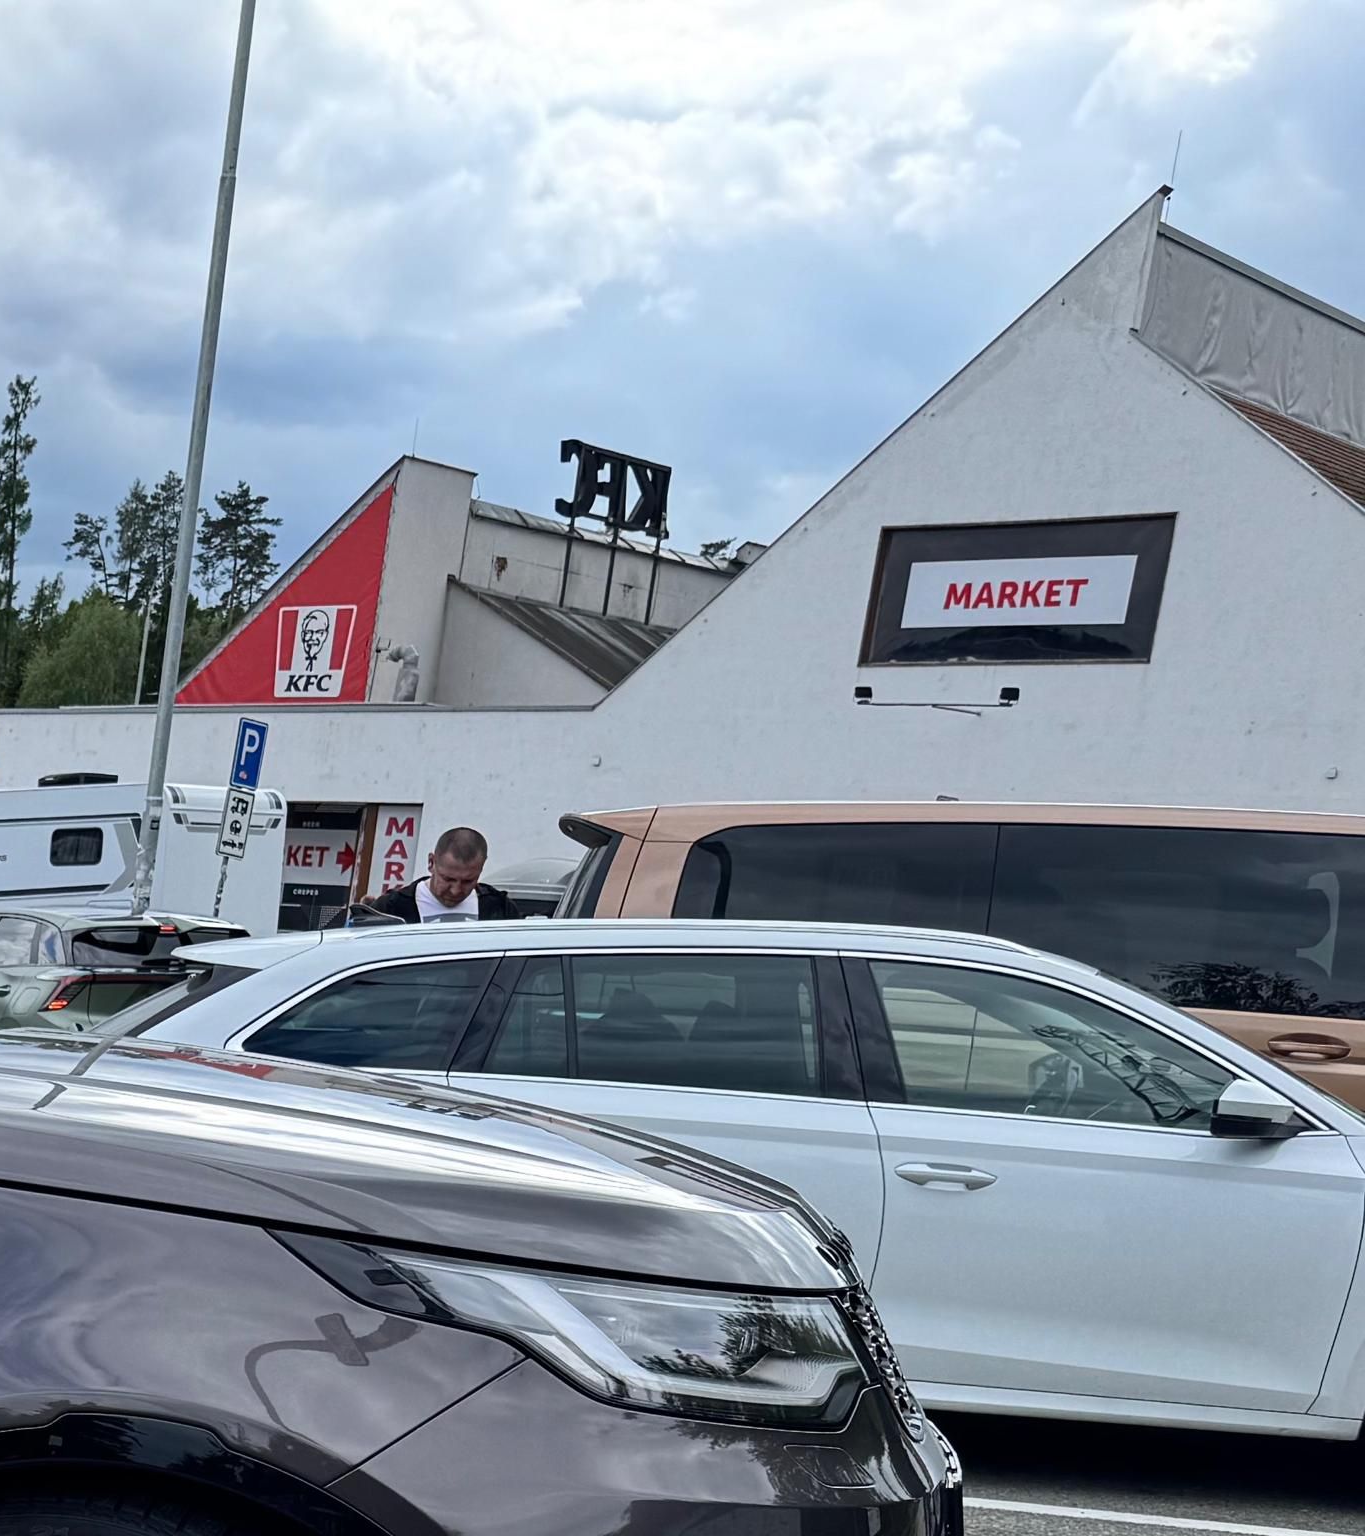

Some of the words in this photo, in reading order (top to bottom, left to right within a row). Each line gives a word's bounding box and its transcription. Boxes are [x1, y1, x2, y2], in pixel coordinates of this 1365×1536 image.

[942, 579, 1089, 610] MARKET
[284, 674, 332, 692] KFC
[240, 728, 260, 766] P
